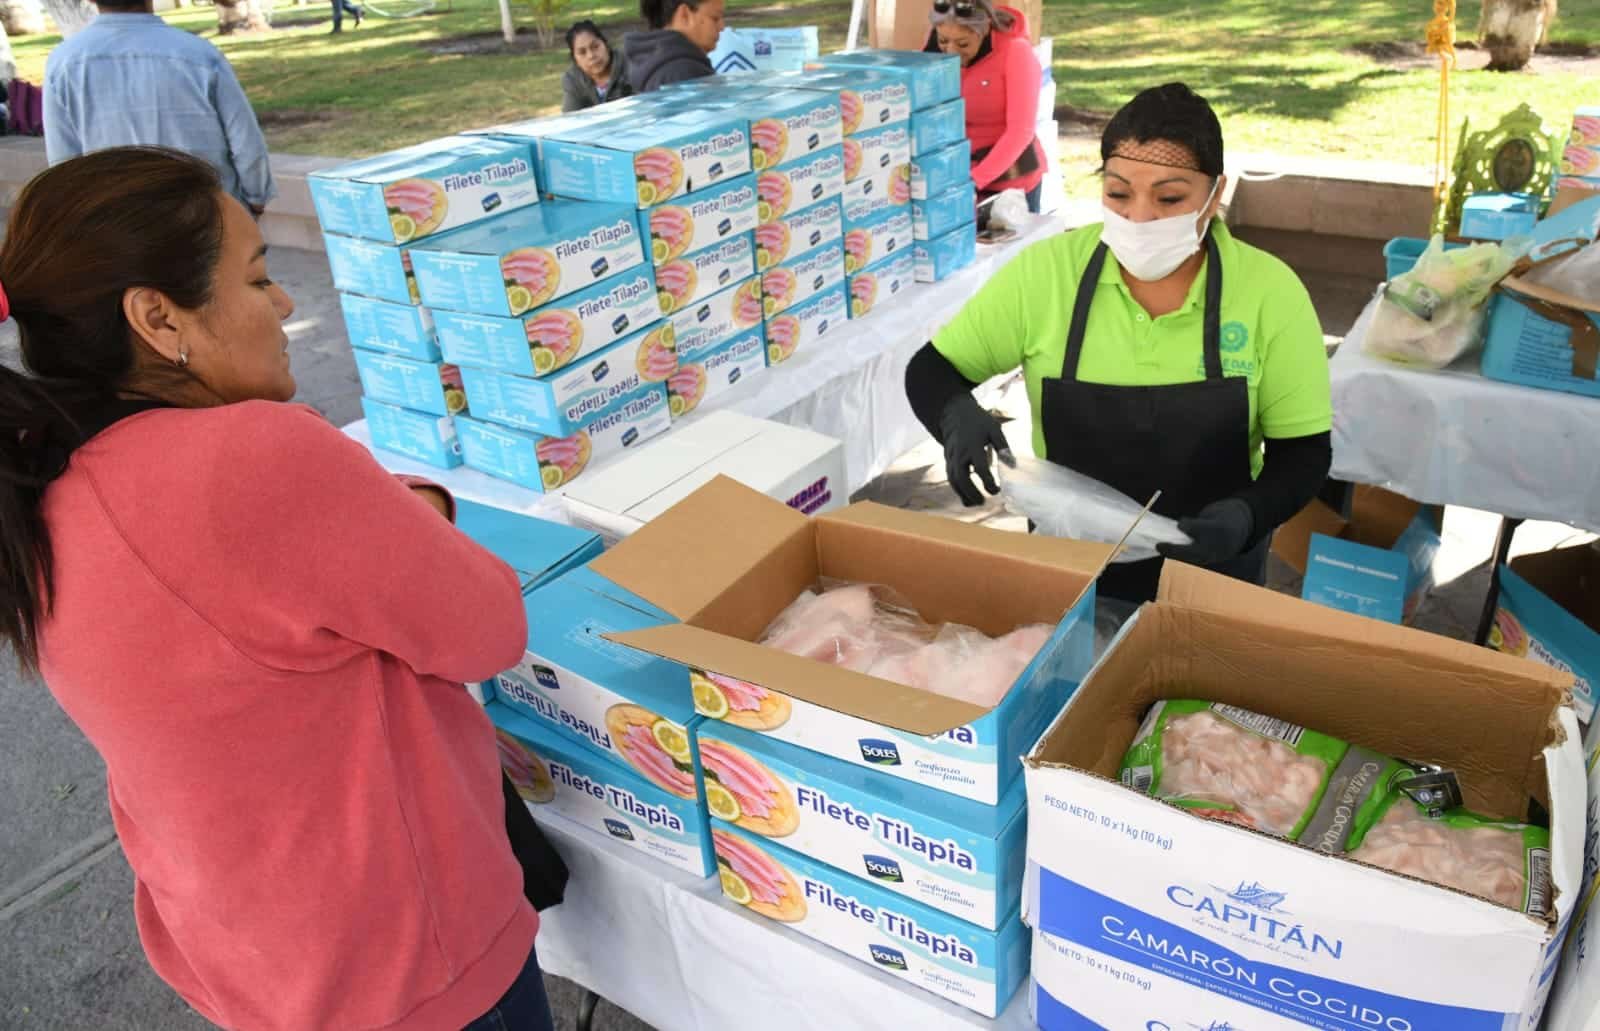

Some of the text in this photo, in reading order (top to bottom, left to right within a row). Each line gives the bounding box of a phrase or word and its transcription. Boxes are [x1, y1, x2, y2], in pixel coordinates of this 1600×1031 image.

[681, 131, 743, 160] Filete Tilapia
[444, 159, 527, 192] Filete Tilapia
[692, 188, 752, 218] Filete Tilapia
[555, 239, 591, 260] Filete
[592, 222, 632, 246] Tilapia
[695, 238, 748, 269] Filete Tilapia
[578, 279, 649, 320] Filete Tilapia
[705, 338, 759, 369] Filete Tilapia
[568, 374, 640, 419] Filete Tilapia
[588, 391, 661, 436] Filete Tilapia
[501, 678, 611, 748] Filete Tilapia
[861, 744, 896, 760] SOLES
[550, 764, 681, 832] Filete Tilapia
[797, 788, 973, 871] Filete Tilapia
[1044, 794, 1068, 811] PESO
[1069, 804, 1099, 823] NETO:
[1101, 815, 1111, 827] 10
[1121, 823, 1125, 833] 1
[1126, 825, 1139, 840] kg
[1141, 830, 1155, 843] (10
[1157, 835, 1174, 850] kg)
[867, 860, 899, 877] SOLES
[804, 880, 974, 965] Filete Tilapia
[1166, 885, 1343, 961] CAPITÁN
[1101, 915, 1257, 986] CAMARÓN
[1268, 977, 1412, 1031] COCIDO
[1110, 966, 1121, 979] kg
[1137, 979, 1152, 991] kg)
